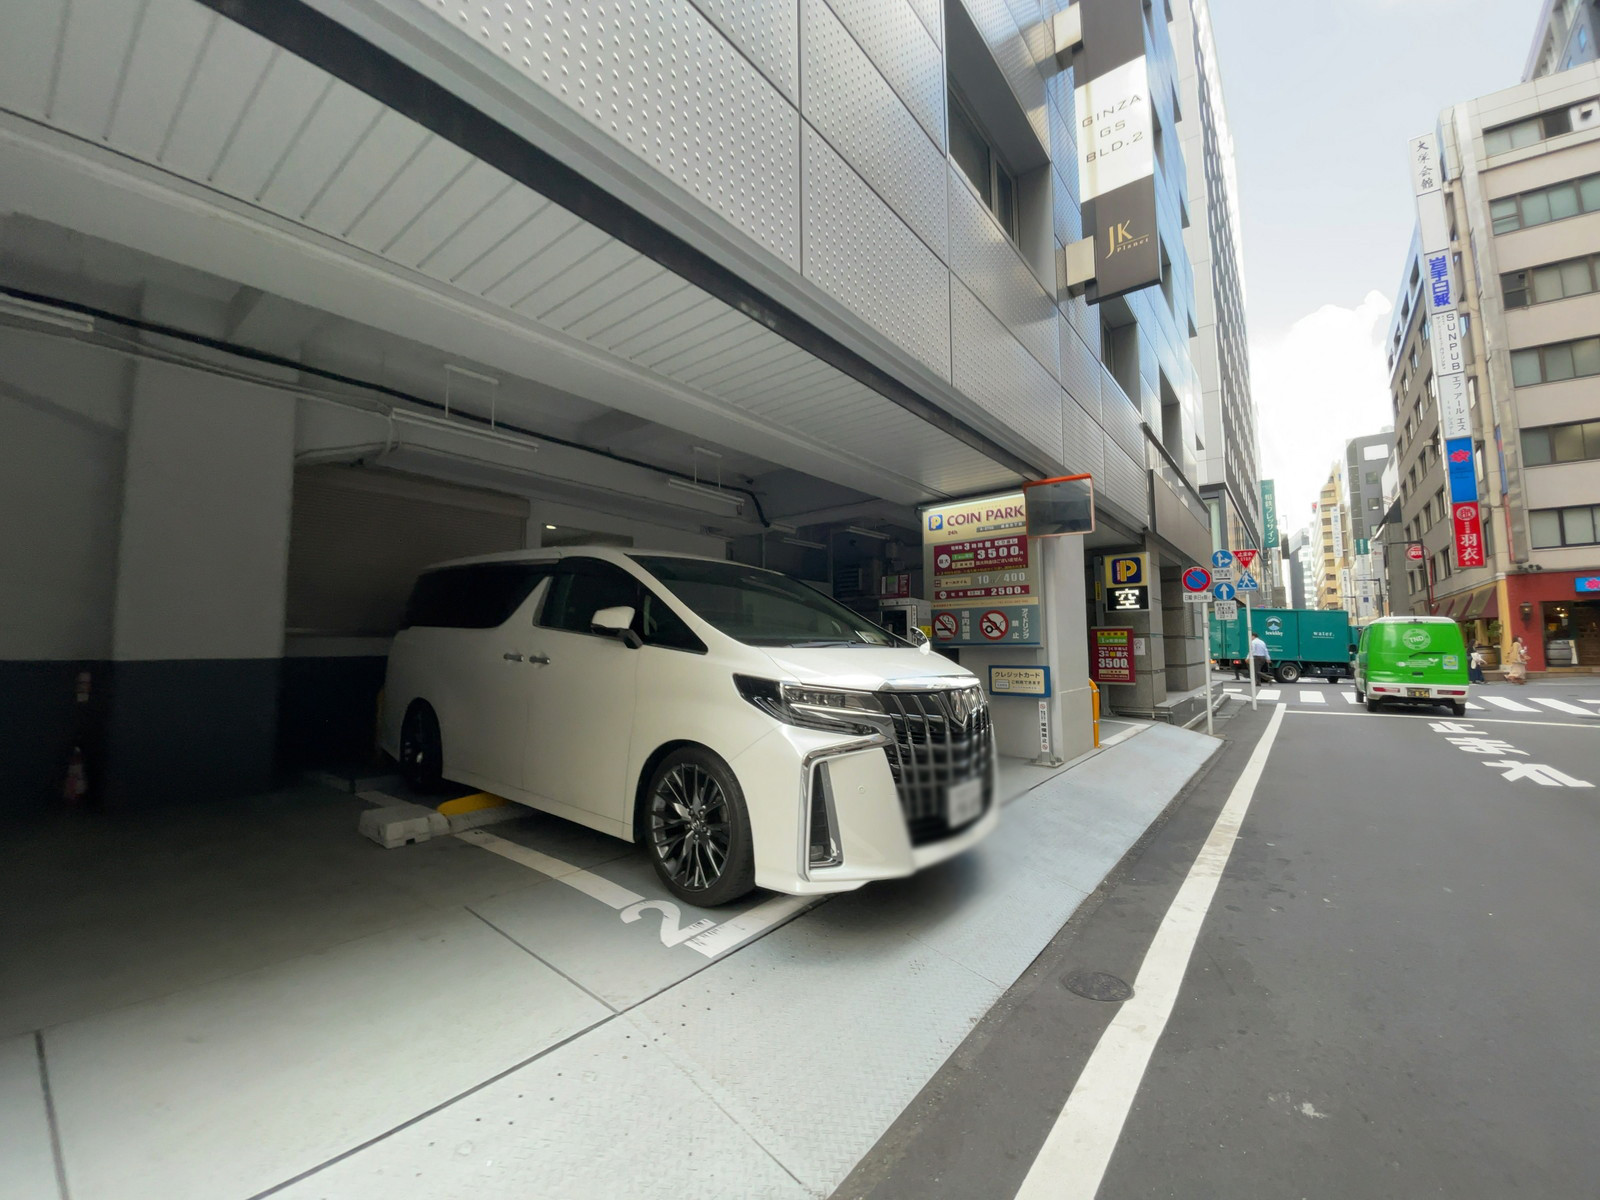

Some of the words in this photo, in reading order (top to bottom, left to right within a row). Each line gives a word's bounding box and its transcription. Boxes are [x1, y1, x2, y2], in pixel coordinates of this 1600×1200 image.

[1082, 94, 1142, 128] GINZA
[1100, 120, 1126, 138] GS
[1086, 131, 1143, 163] BLD.2
[1105, 219, 1133, 259] JK
[1116, 237, 1149, 252] Planet
[1429, 255, 1451, 307] 岩手日報
[1446, 313, 1461, 371] SUNPUB
[947, 511, 981, 526] COIN
[986, 505, 1025, 521] PARK
[1460, 534, 1479, 561] 羽衣
[1115, 588, 1140, 609] 空
[994, 671, 1040, 679] クレジットカード
[1098, 658, 1128, 668] 3500
[1428, 721, 1596, 787] 止まれ
[620, 900, 717, 948] 2
